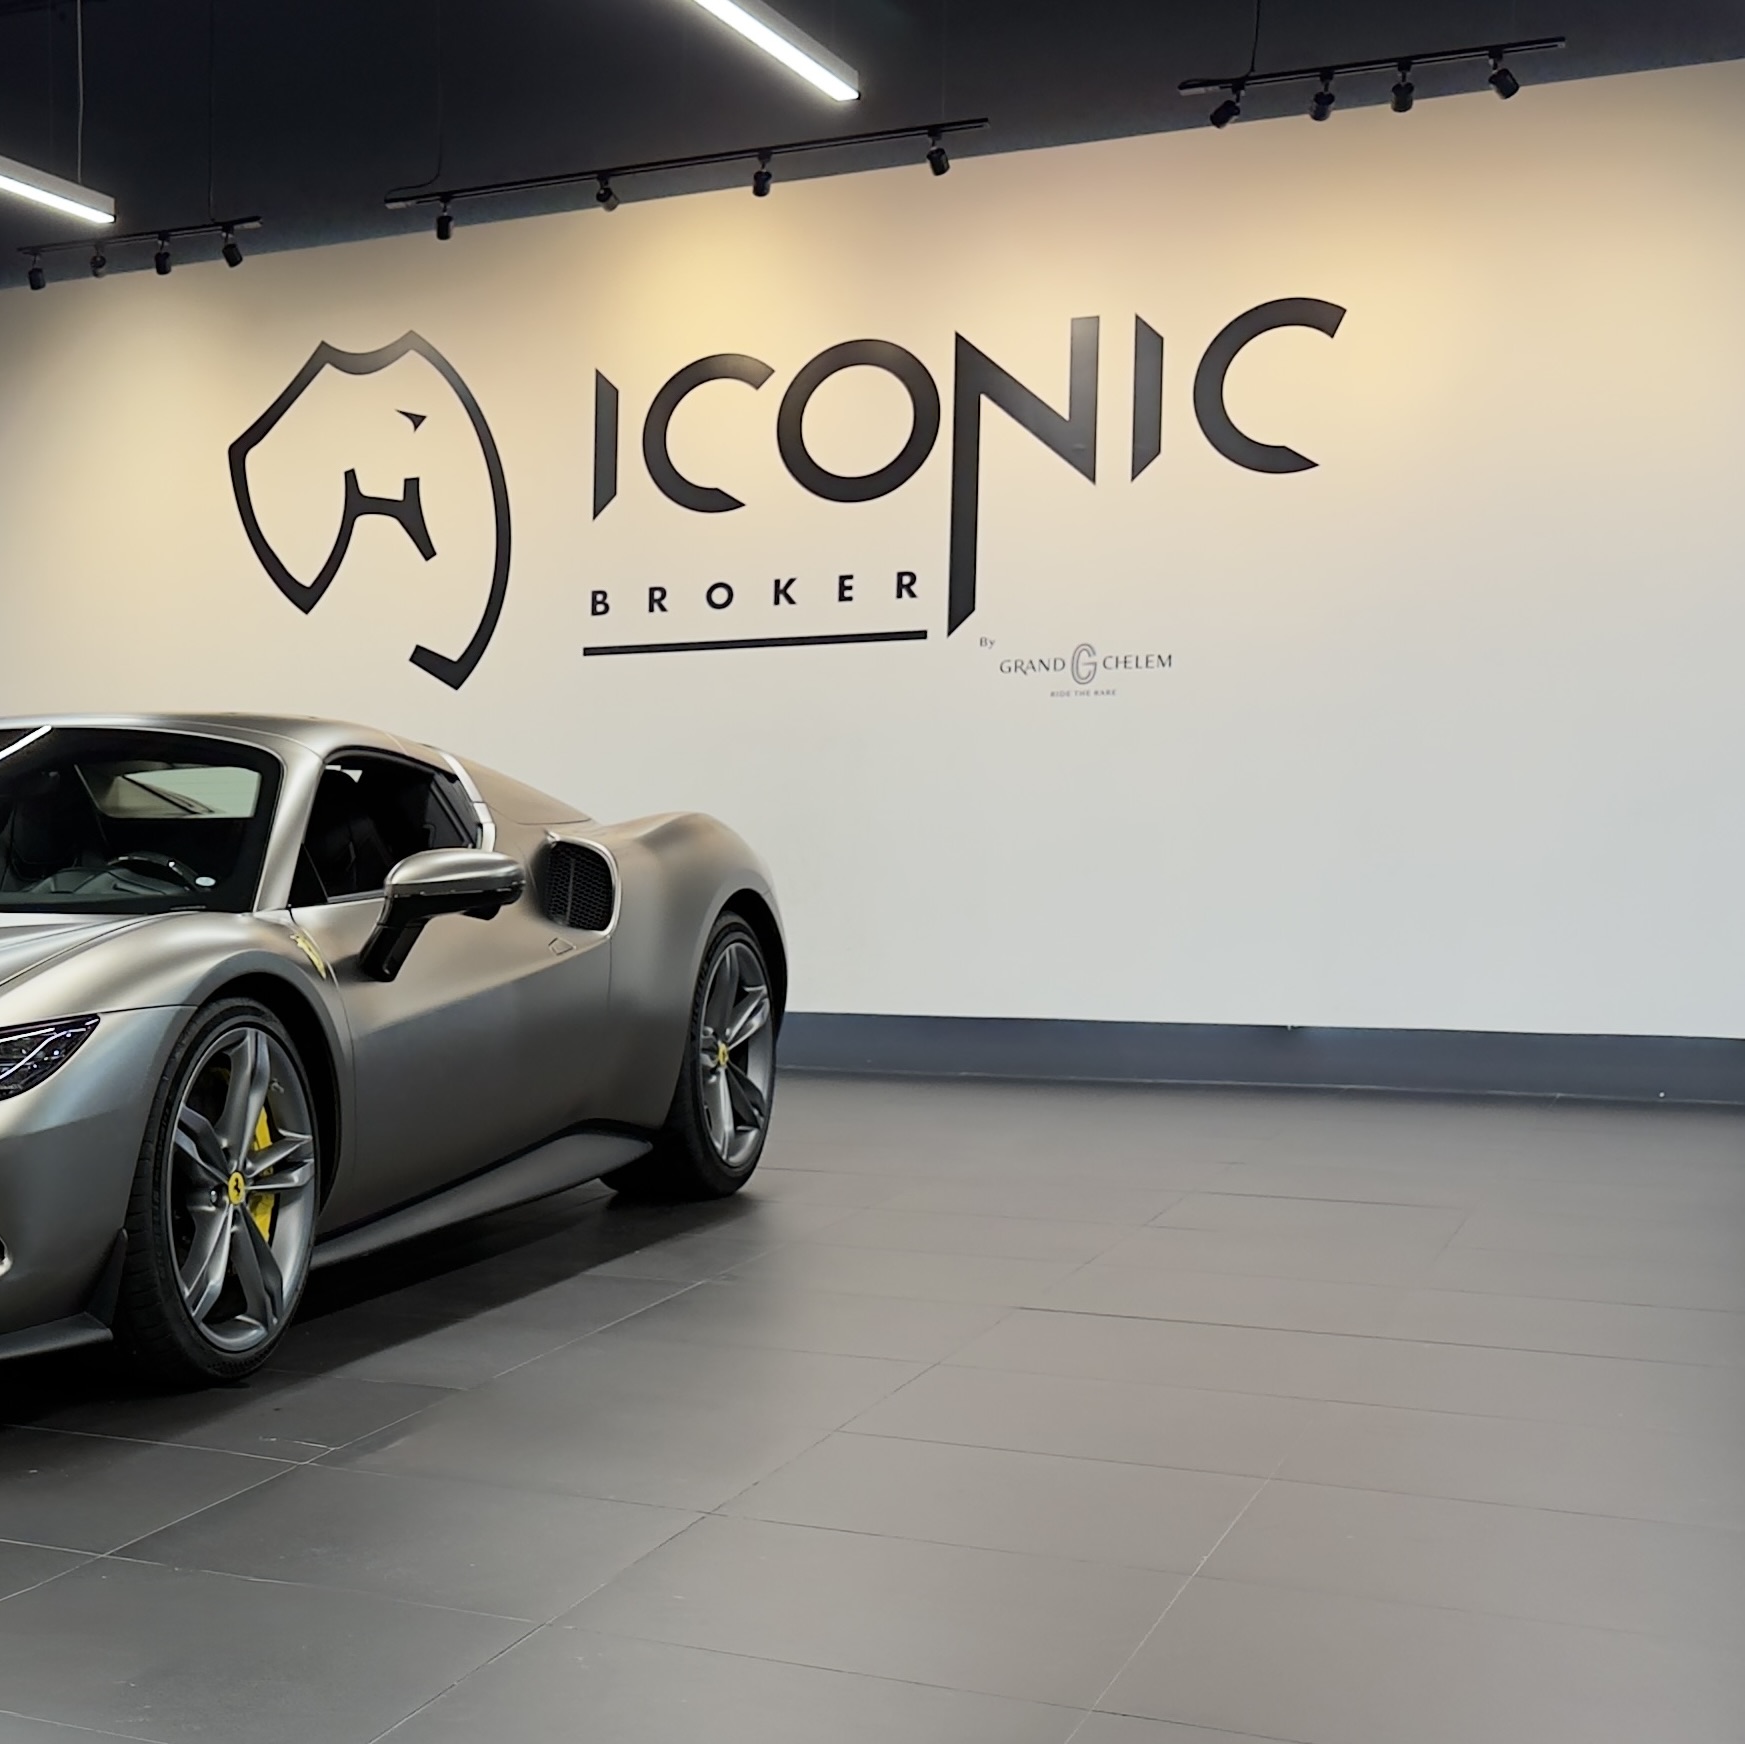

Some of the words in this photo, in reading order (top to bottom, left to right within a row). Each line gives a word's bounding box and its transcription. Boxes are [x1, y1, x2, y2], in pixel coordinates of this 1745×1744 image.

[592, 297, 1347, 637] ICONIC
[591, 570, 918, 616] BROKER
[979, 637, 996, 650] By
[999, 657, 1066, 676] GRAND
[1102, 653, 1173, 670] CHELEM
